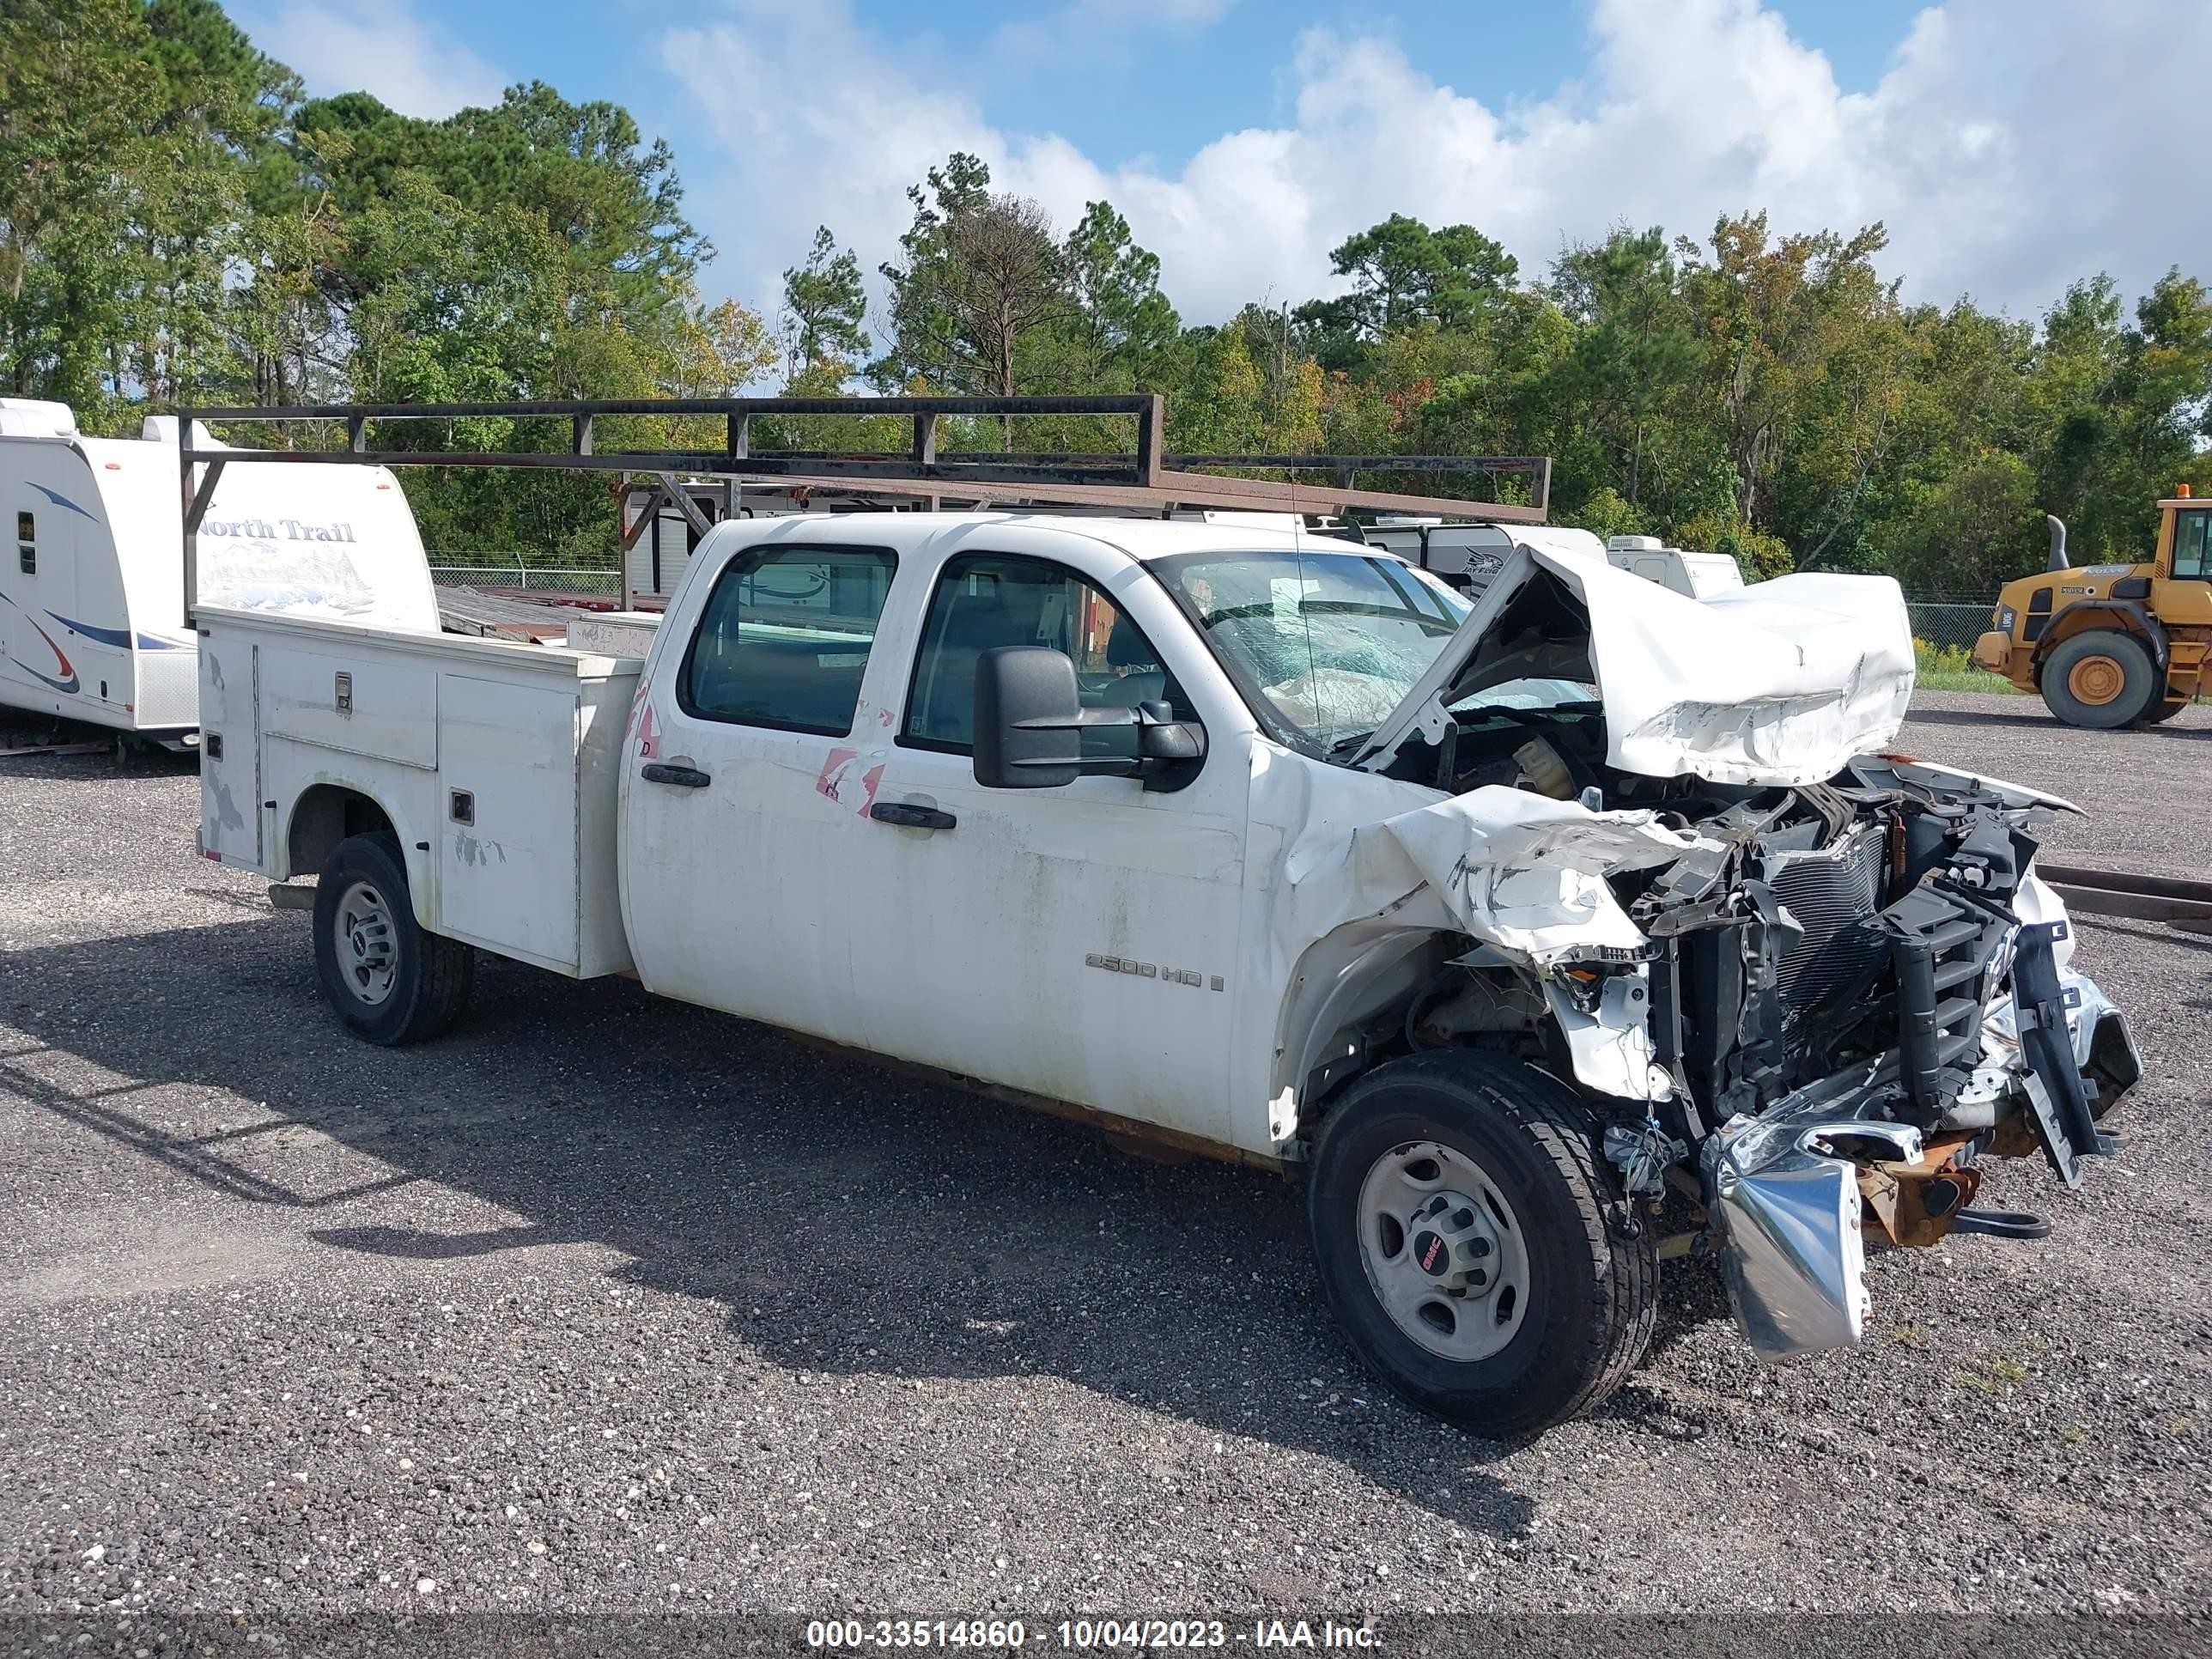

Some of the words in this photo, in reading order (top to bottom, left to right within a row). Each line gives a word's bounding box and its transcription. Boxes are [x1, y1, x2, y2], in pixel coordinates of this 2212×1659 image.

[279, 520, 356, 543] Trail
[2002, 612, 2013, 628] L90G
[1085, 953, 1157, 978] 2500
[1162, 966, 1202, 988] HD
[1423, 1236, 1442, 1271] GMC
